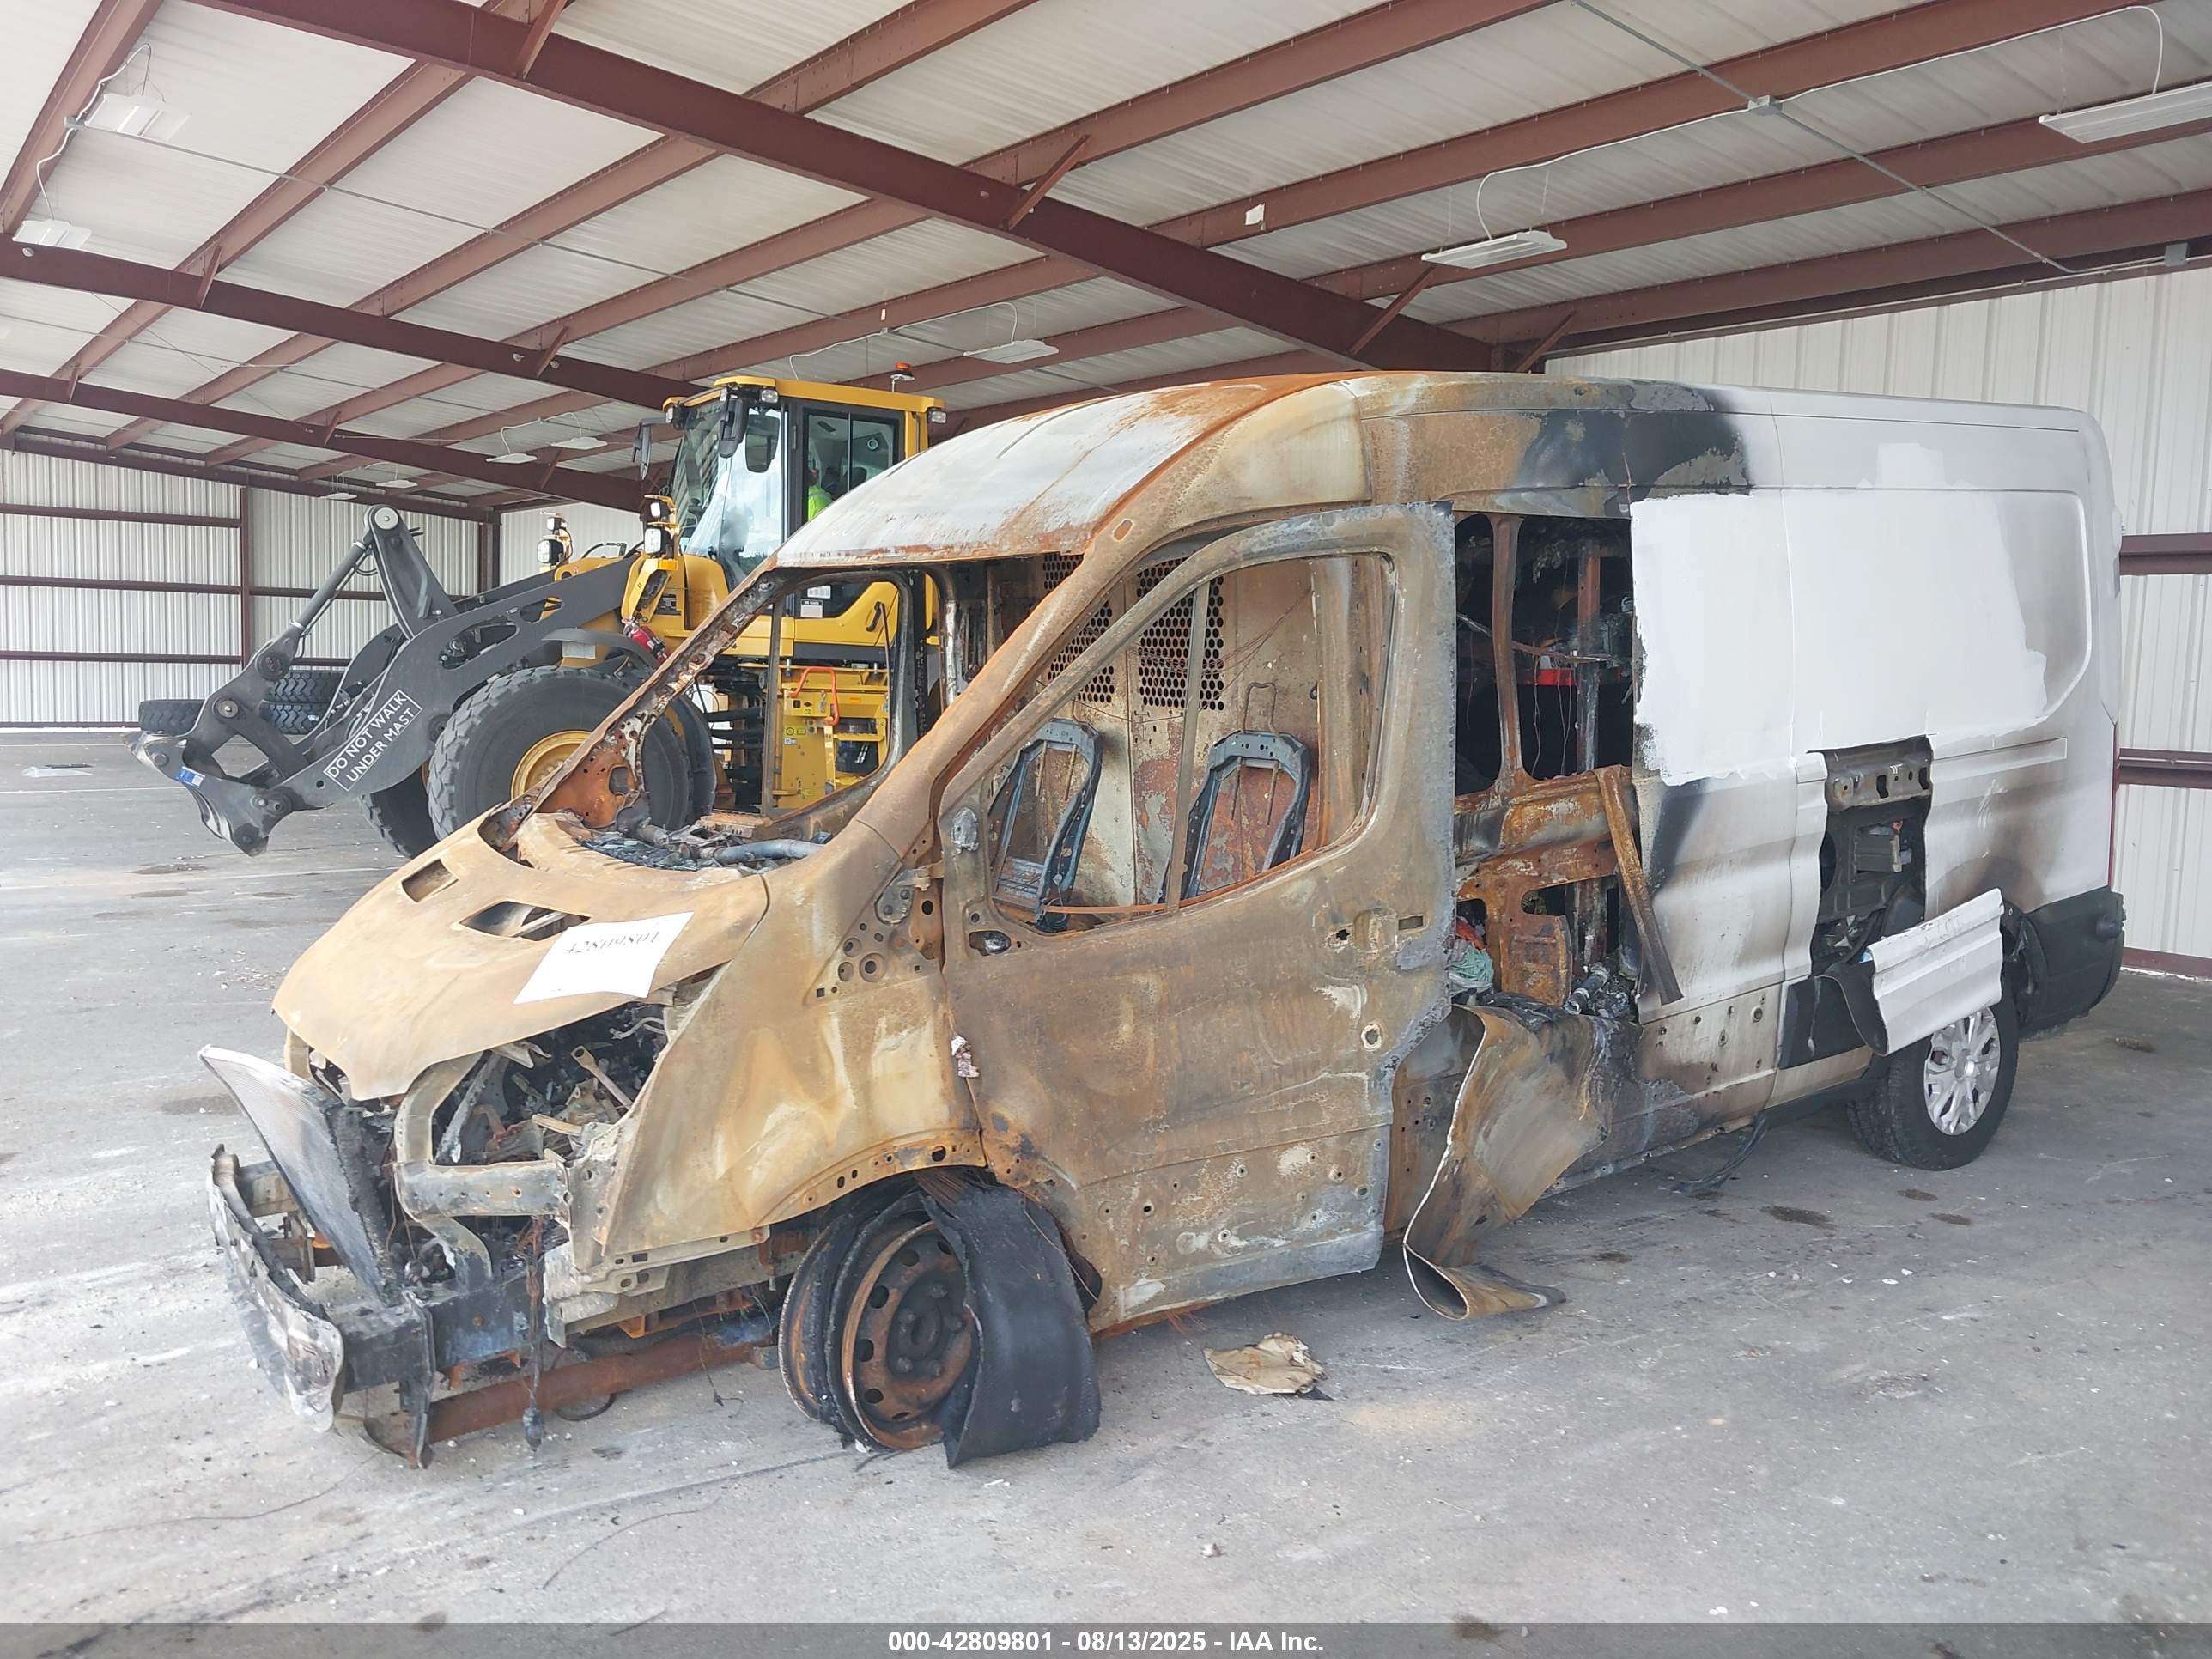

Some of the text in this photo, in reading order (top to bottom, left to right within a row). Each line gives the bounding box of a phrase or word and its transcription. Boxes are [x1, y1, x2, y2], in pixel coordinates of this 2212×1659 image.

[327, 694, 408, 778] DO NOT WALK
[347, 708, 415, 781] UNDER MAST
